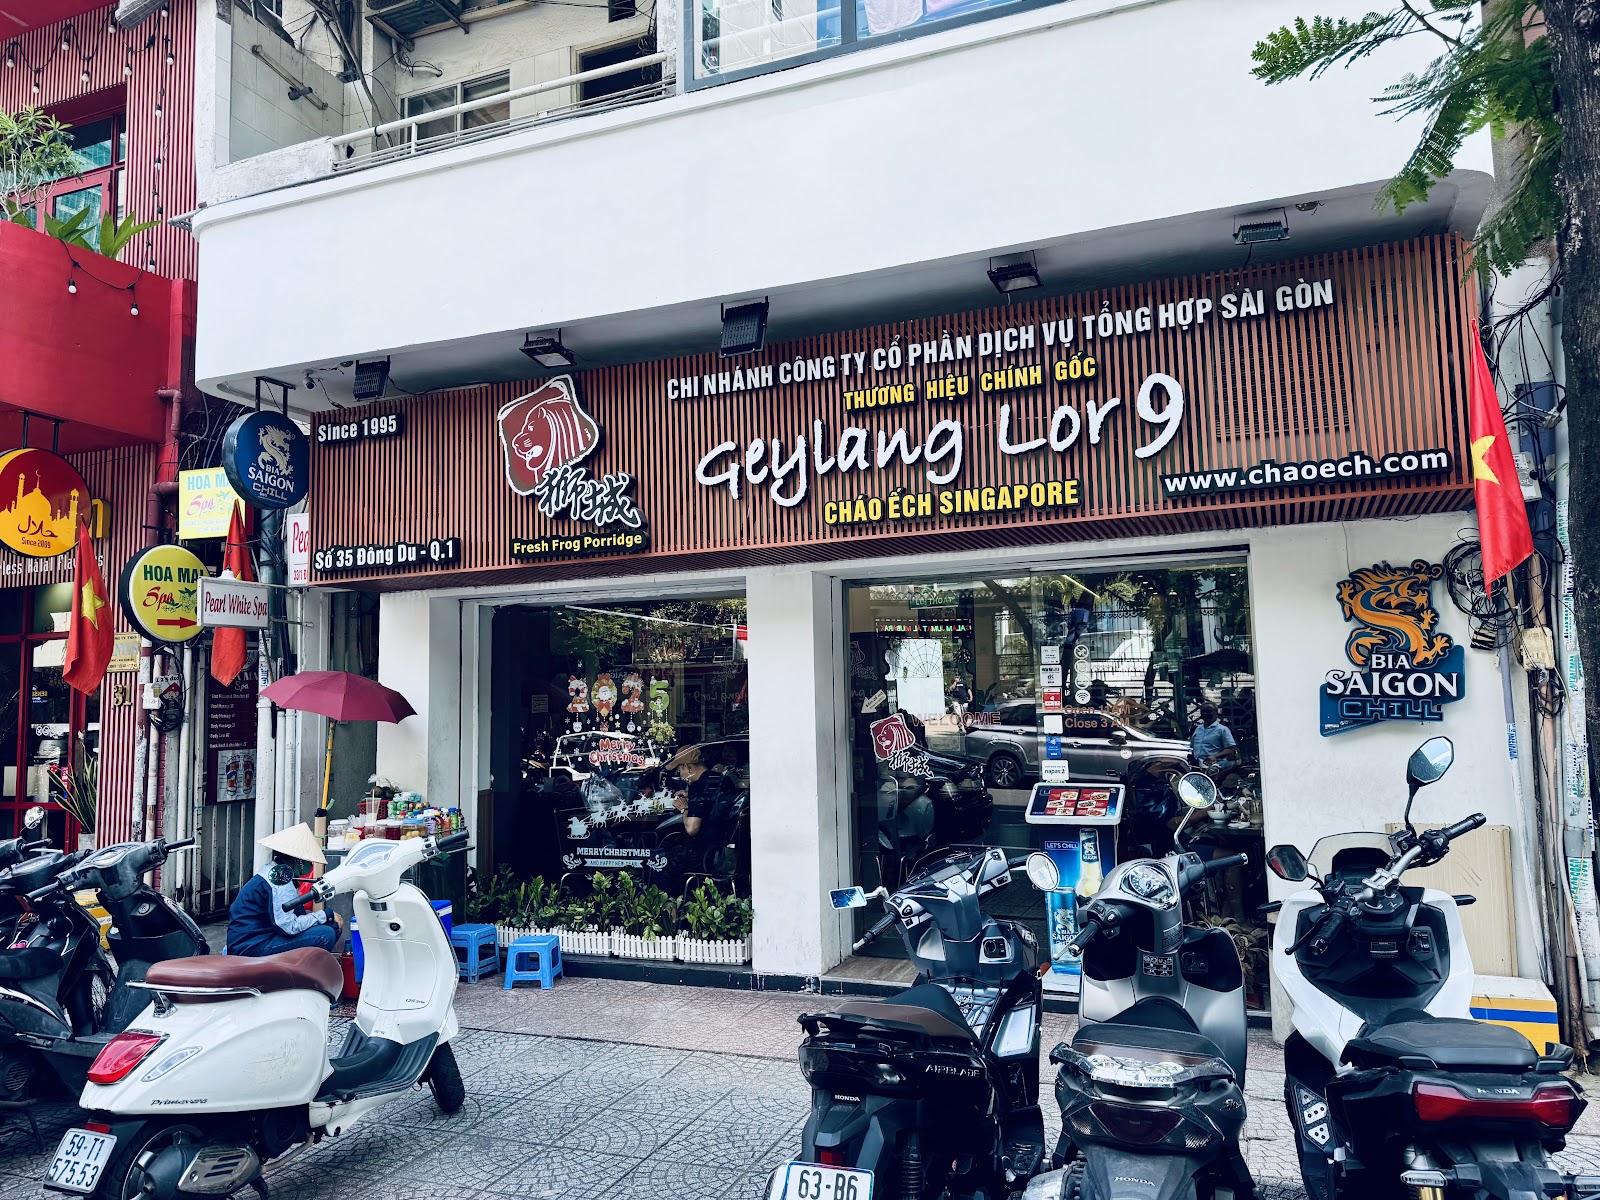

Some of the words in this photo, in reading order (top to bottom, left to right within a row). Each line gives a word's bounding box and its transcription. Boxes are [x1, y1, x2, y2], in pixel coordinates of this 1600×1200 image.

[667, 376, 699, 400] CHI
[703, 365, 774, 396] NHÁNH
[778, 356, 836, 384] CÔNG
[841, 351, 867, 375] TY
[873, 334, 902, 371] CỔ
[908, 329, 973, 367] PHẦN
[978, 325, 1035, 358] DỊCH
[1043, 318, 1074, 347] VỤ
[1082, 300, 1152, 340] TỔNG
[1159, 298, 1213, 330] HỢP
[1220, 288, 1265, 319] SÀI
[1275, 278, 1334, 312] GÒN
[844, 383, 915, 410] THƯƠNG
[926, 373, 969, 401] HIỆU
[981, 361, 1042, 392] CHÍNH
[1055, 351, 1096, 381] GỐC
[318, 424, 358, 442] Since
[362, 415, 397, 436] 1995
[695, 419, 963, 507] Geylang
[999, 397, 1121, 455] Lor
[1134, 373, 1184, 459] 9
[247, 466, 295, 493] SAIGON
[265, 465, 280, 476] BIA
[1164, 451, 1448, 493] www.chaoech.com
[187, 475, 211, 491] HOA
[252, 481, 288, 501] CHILL
[825, 494, 882, 524] CHÁO
[888, 487, 932, 519] ẾCH
[939, 479, 1079, 515] SINGAPORE
[17, 514, 58, 539] حلال
[21, 537, 37, 547] Since
[37, 539, 51, 549] 2009
[513, 540, 549, 554] Fresh
[552, 539, 581, 552] Frog
[584, 533, 642, 549] Porridge
[315, 548, 333, 570] Số
[336, 549, 353, 568] 35
[356, 546, 394, 567] Đông
[397, 544, 417, 562] Du
[430, 539, 453, 561] Q.1
[27, 557, 53, 574] Halal
[143, 565, 174, 583] HOA
[143, 586, 174, 612] Spa
[204, 591, 227, 614] Pearl
[228, 593, 252, 615] White
[252, 596, 268, 620] Spa
[1371, 654, 1411, 669] BIA
[1325, 670, 1459, 697] SAIGON
[113, 684, 133, 707] 31
[911, 712, 1002, 727] WELCOME
[1064, 704, 1096, 716] Open
[1342, 701, 1443, 719] CHILL
[1064, 718, 1098, 729] Close
[1100, 718, 1108, 729] 3
[1111, 718, 1131, 728] AM
[599, 737, 635, 752] Merry
[588, 750, 645, 765] Christmas
[576, 847, 604, 857] MERRY
[604, 848, 651, 858] CHRISTMAS
[834, 1094, 861, 1102] HONDA
[1477, 1087, 1521, 1095] HONDA
[151, 1098, 208, 1106] Primavera
[50, 1158, 100, 1188] 575.53
[1114, 1176, 1156, 1187] HONDA
[798, 1169, 858, 1200] 63-B6
